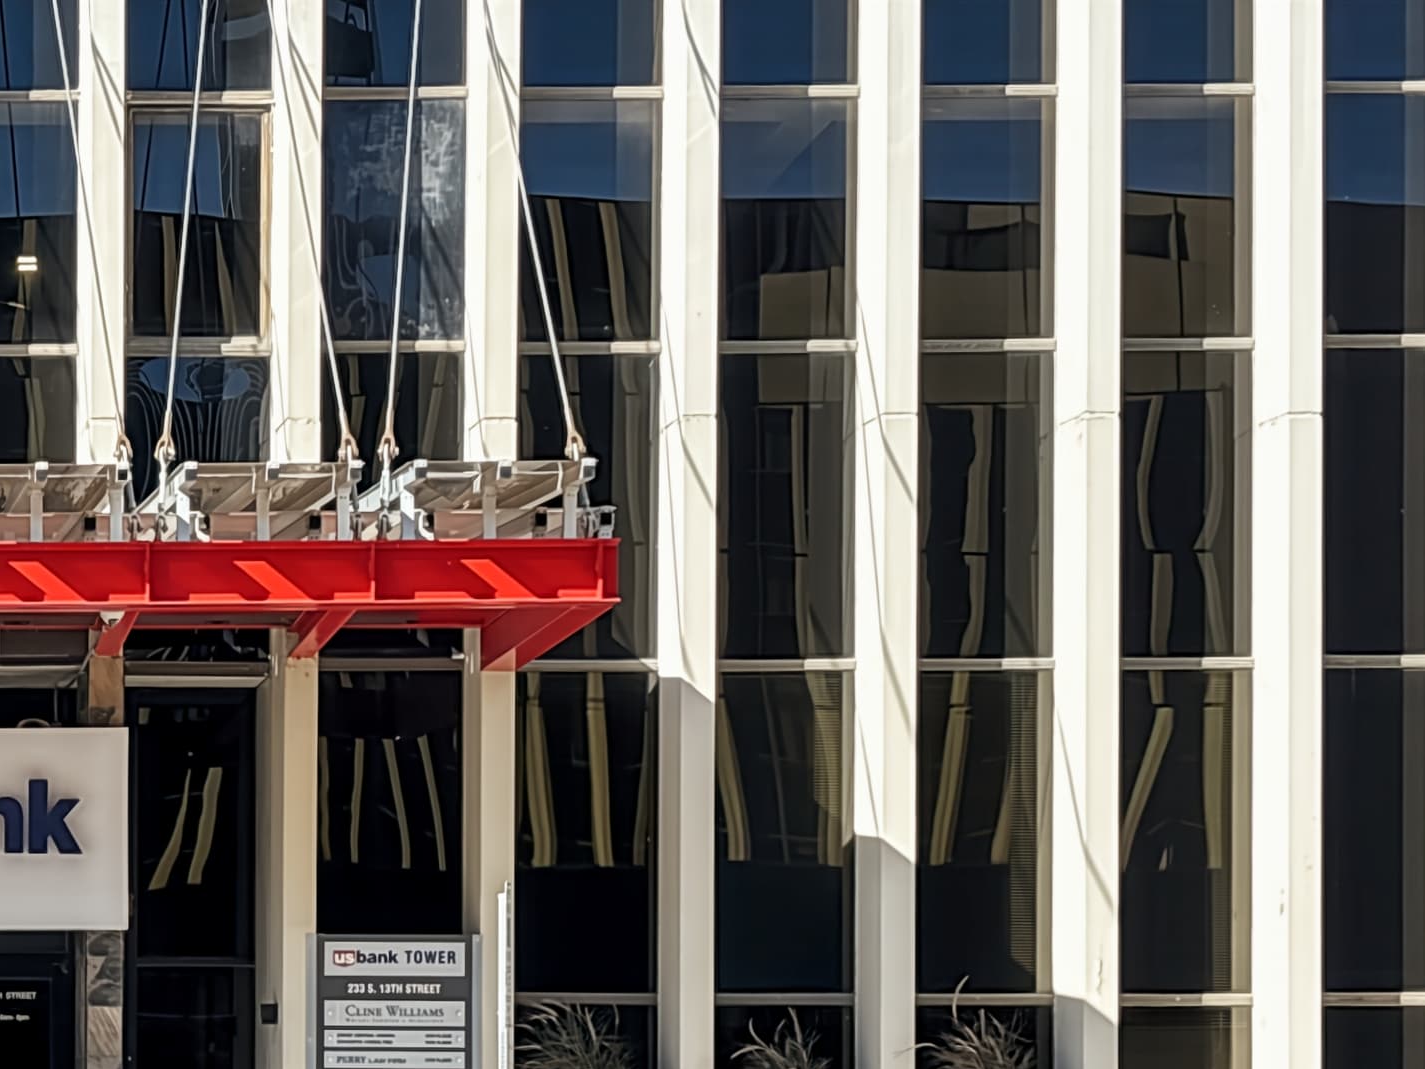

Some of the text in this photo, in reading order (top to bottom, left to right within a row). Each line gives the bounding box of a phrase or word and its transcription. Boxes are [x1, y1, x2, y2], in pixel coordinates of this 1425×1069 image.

[404, 950, 456, 964] TOWER
[347, 983, 441, 994] 233 S. 13TH STREET
[6, 991, 37, 1000] STREET
[345, 1004, 444, 1017] CLINE WILLIAMS
